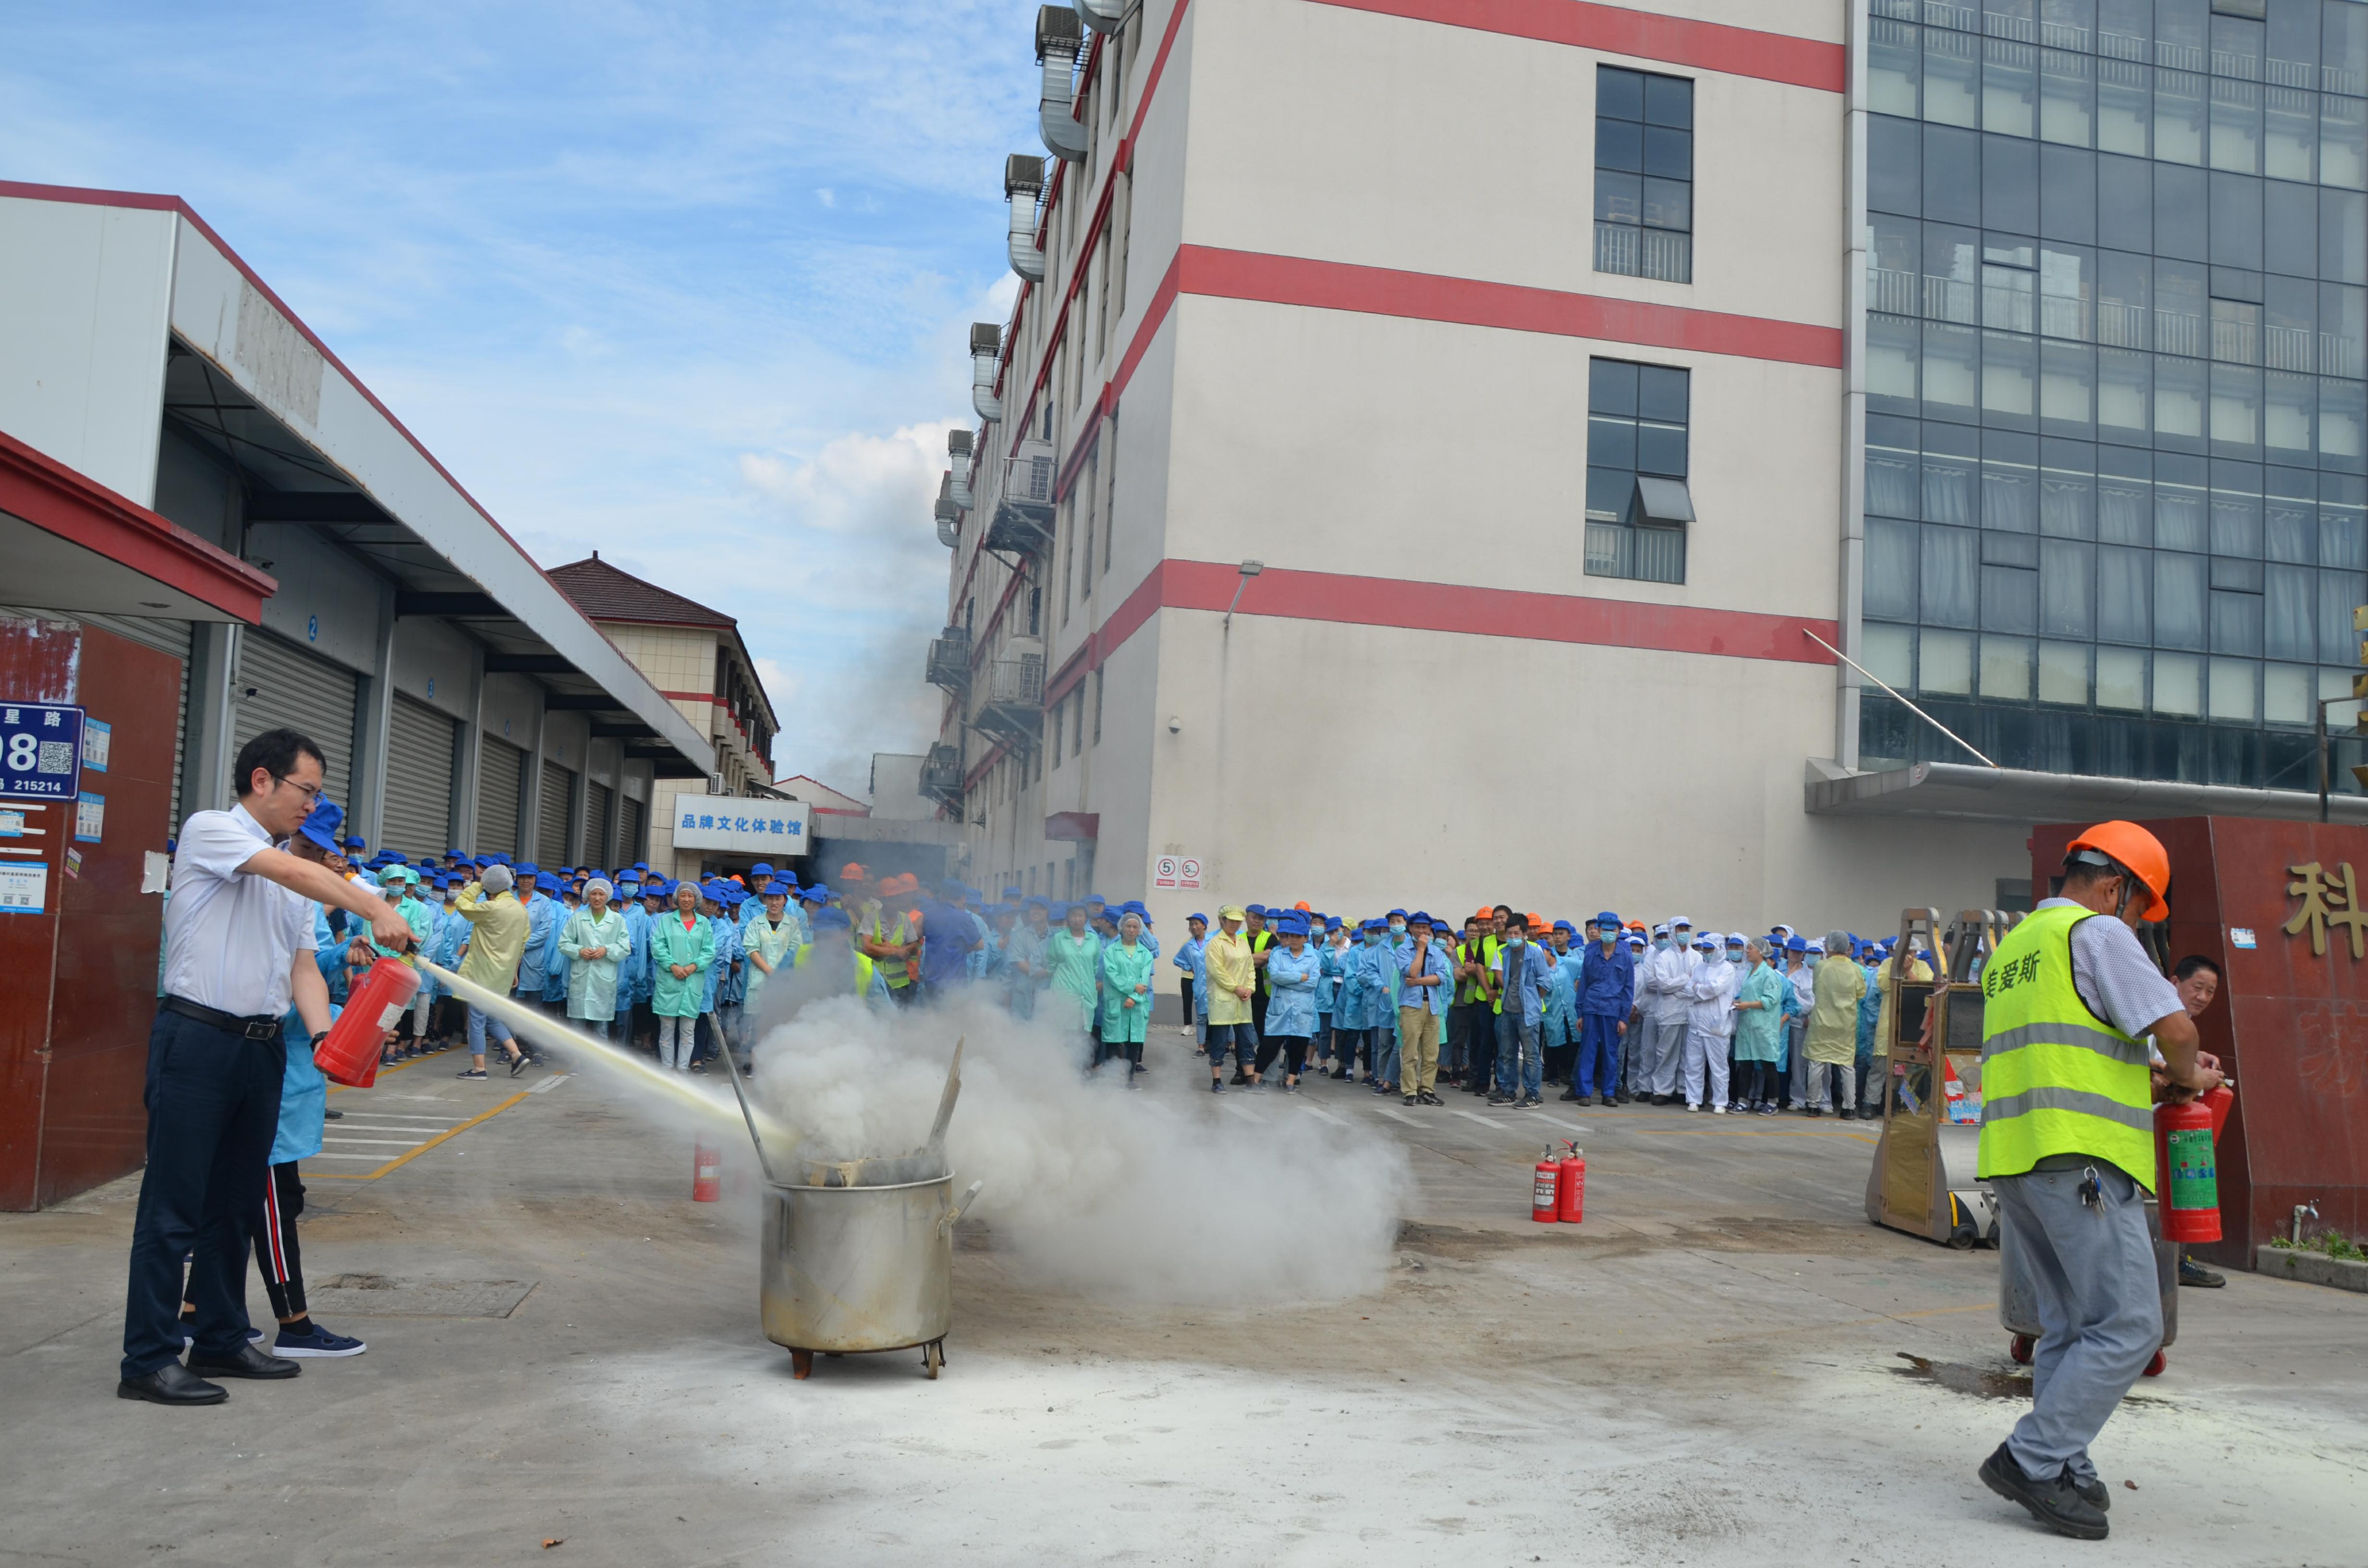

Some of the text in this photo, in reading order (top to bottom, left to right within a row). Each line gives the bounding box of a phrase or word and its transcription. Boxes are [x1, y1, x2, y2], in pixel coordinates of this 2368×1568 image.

[310, 618, 316, 637] 2
[0, 733, 37, 772] 8
[14, 780, 62, 792] 215214
[681, 814, 802, 835] 品牌文化体验馆
[1163, 862, 1171, 873] 5
[2285, 861, 2368, 959] 科
